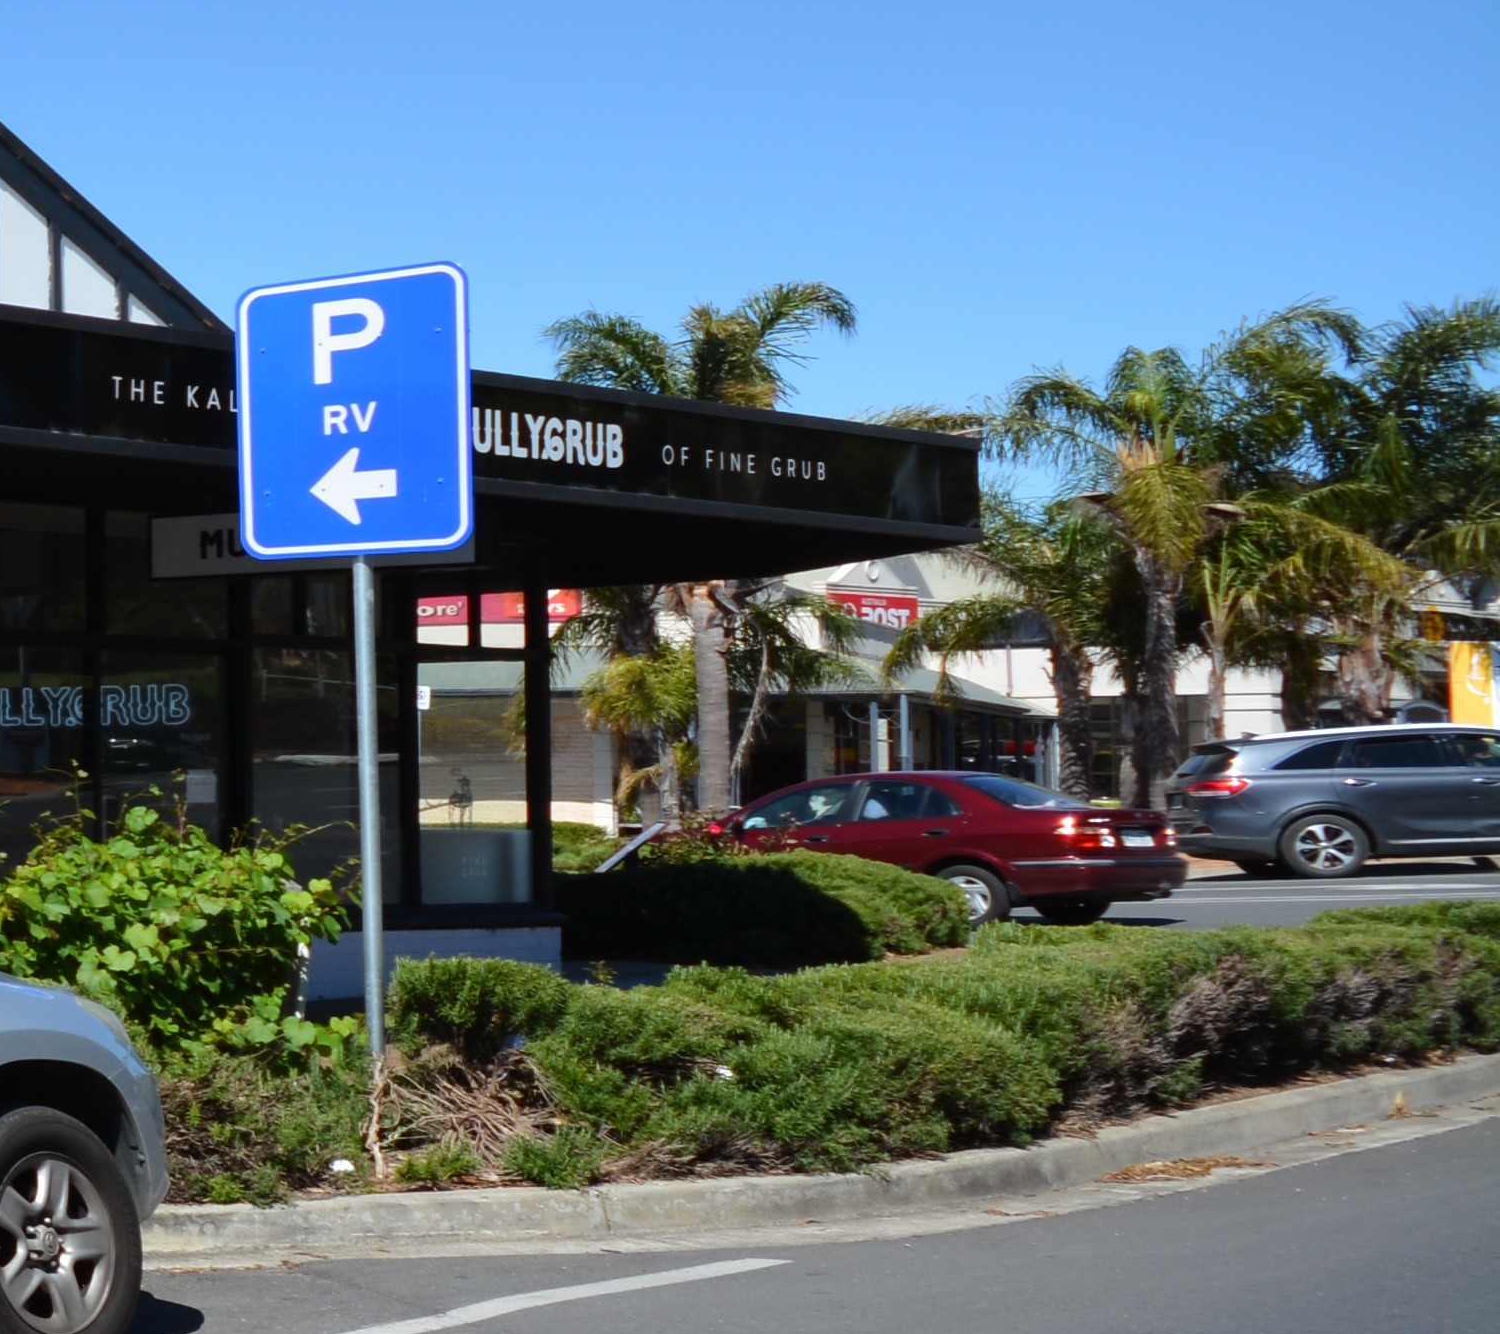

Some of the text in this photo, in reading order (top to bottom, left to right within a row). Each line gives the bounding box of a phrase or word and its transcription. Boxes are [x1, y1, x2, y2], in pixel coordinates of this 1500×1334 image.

[312, 297, 385, 385] P
[111, 375, 166, 405] THE
[323, 401, 377, 436] RV
[472, 407, 827, 482] ULLYGRUB OF FINE GRUB
